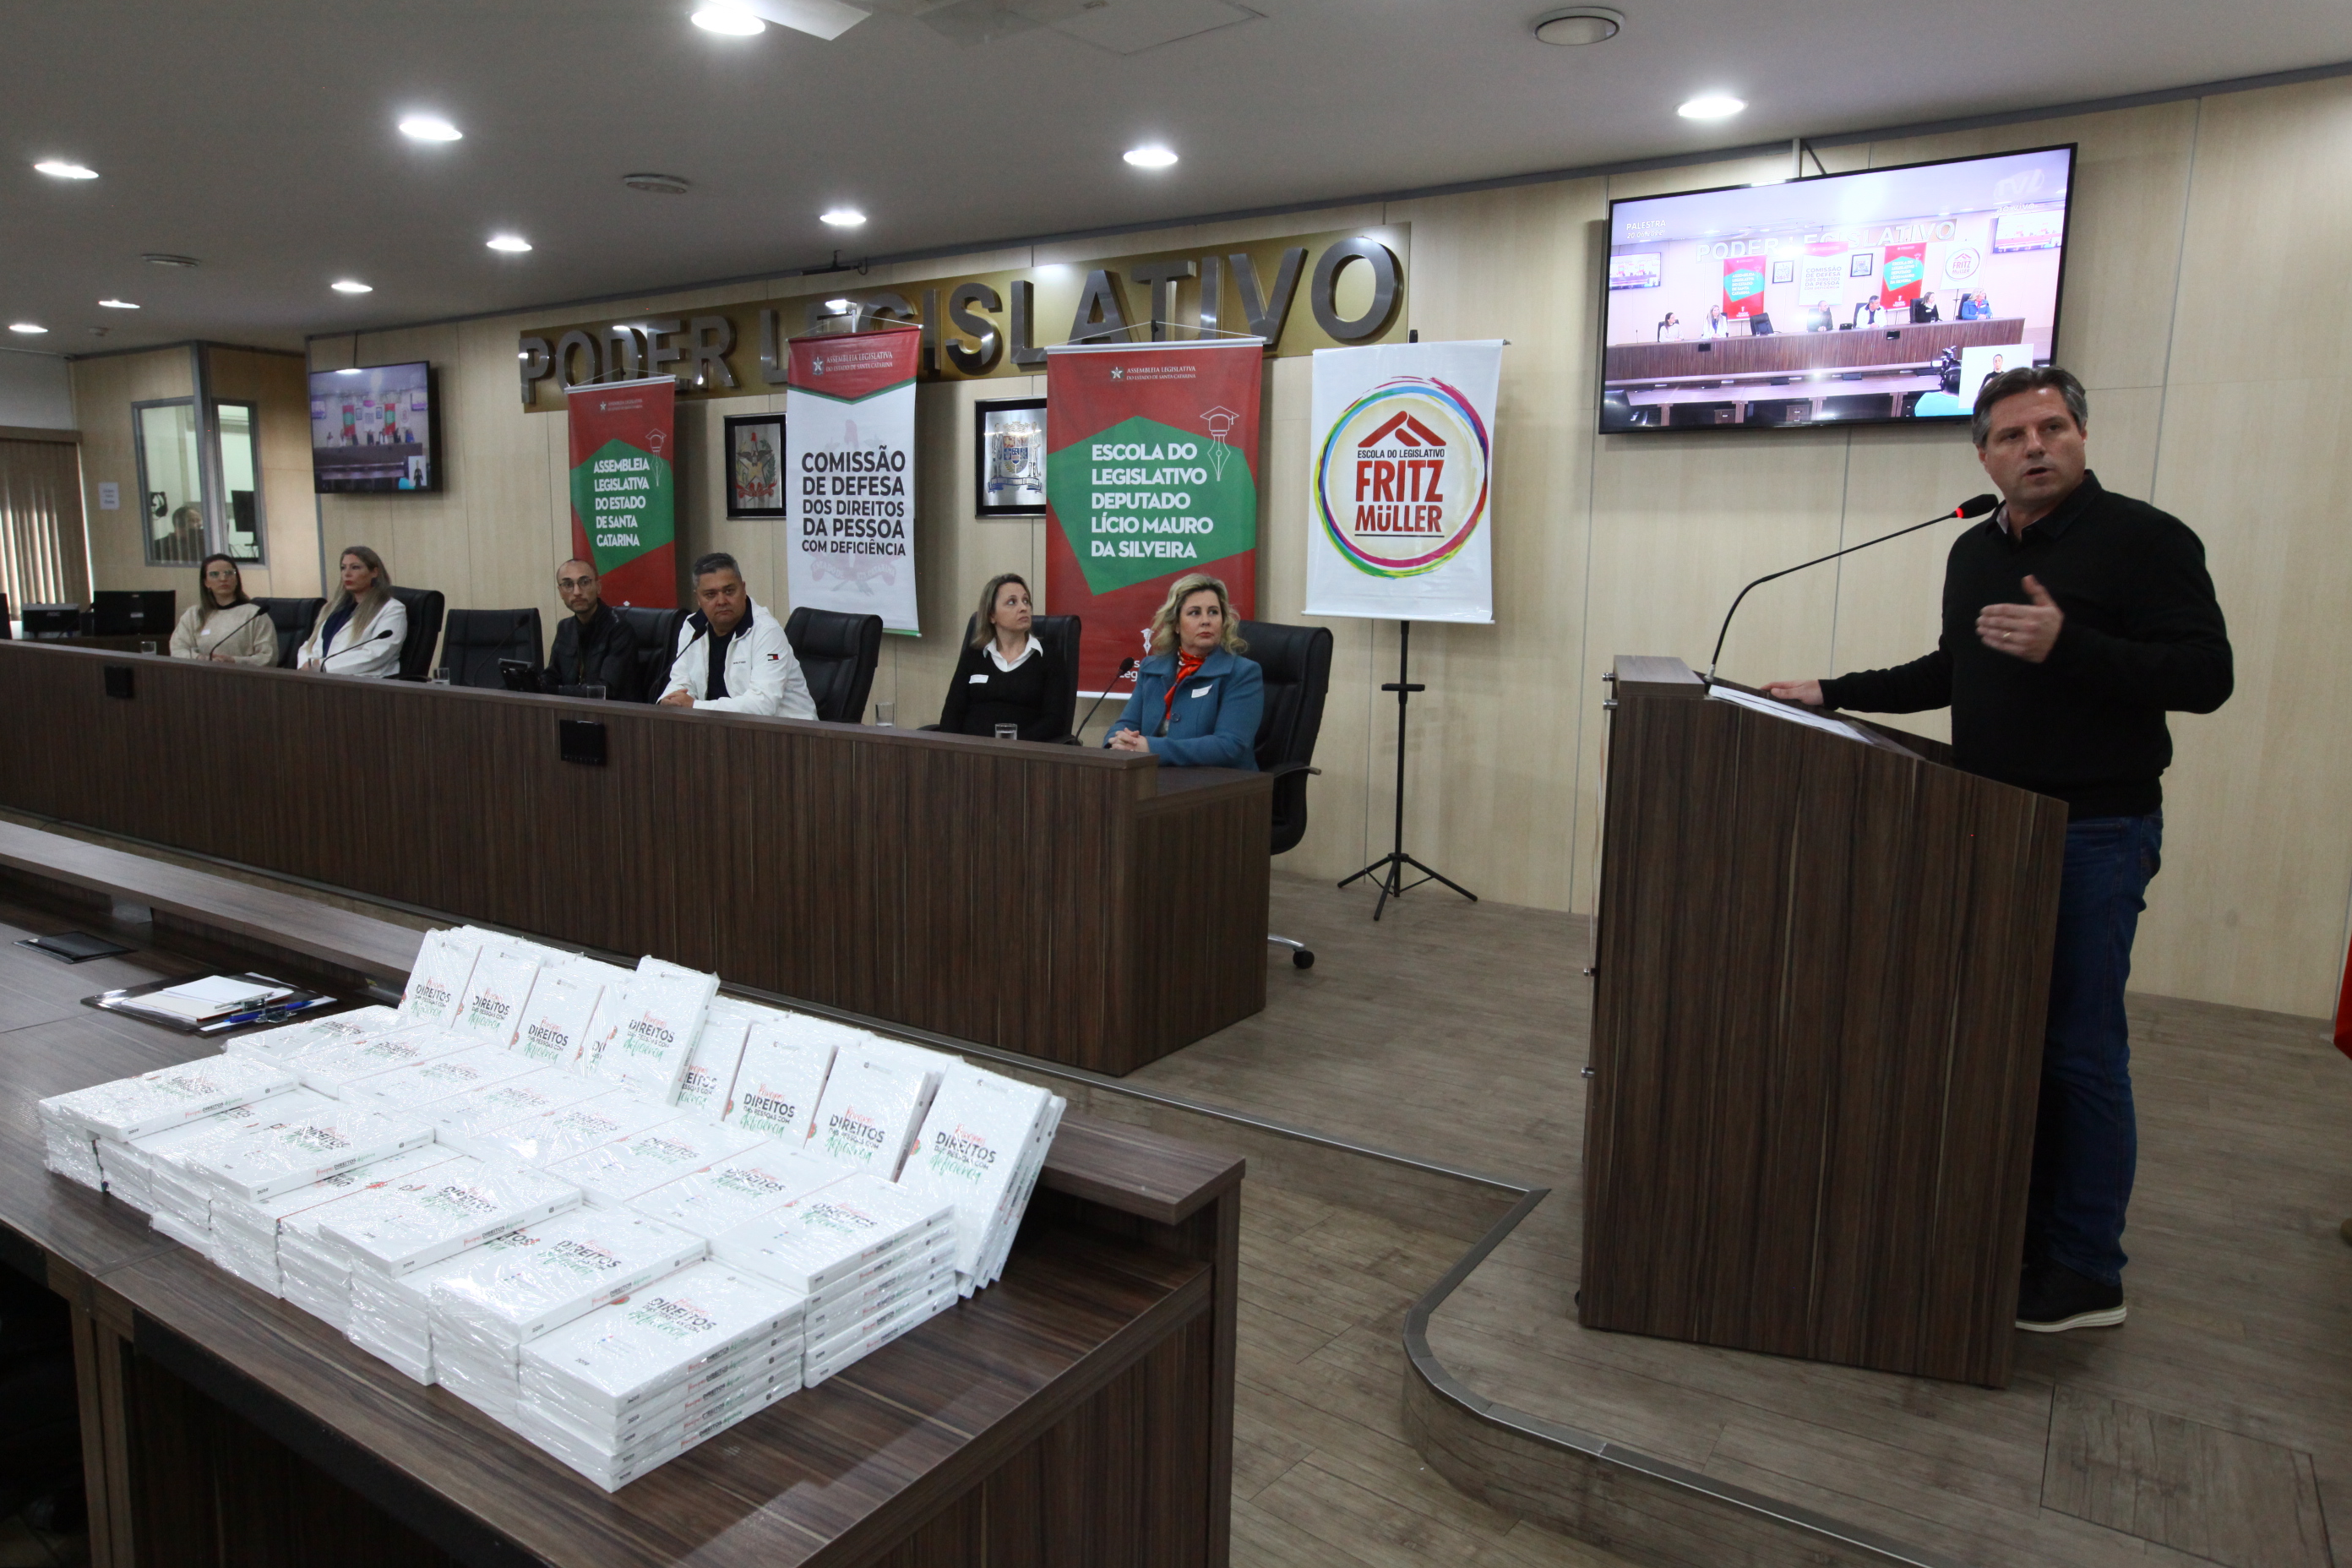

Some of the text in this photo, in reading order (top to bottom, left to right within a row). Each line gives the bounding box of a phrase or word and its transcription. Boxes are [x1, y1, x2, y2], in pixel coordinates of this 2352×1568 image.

[1626, 220, 1666, 230] PALESTRA
[518, 314, 739, 405] PODER
[826, 351, 893, 362] ASSEMBLEIA LEGISLATIVA
[802, 445, 906, 472] COMISSÃO
[1092, 443, 1198, 461] ESCOLA DO
[1358, 449, 1445, 458] ESCOLA DO LEGISLATIVO
[593, 458, 650, 473] ASSEMBLEIA
[594, 477, 650, 492] LEGISLATIVA
[1092, 467, 1207, 485] LEGISLATIVO
[1355, 460, 1445, 502] FRITZ
[803, 476, 905, 496] DE DEFESA
[596, 496, 646, 510] DO ESTADO
[803, 499, 904, 518] DOS DIREITOS
[1092, 493, 1191, 509] DEPUTADO
[596, 515, 638, 528] DE SANTA
[803, 518, 905, 539] DA PESSOA
[1092, 512, 1214, 534] LÍCIO MAURO
[596, 534, 640, 547] CATARINA
[802, 539, 906, 556] COM DEFICIÊNCIA
[1091, 541, 1197, 558] DA SILVEIRA
[416, 984, 451, 1003] DIREITOS
[472, 996, 510, 1015] DIREITOS
[528, 1024, 569, 1047] DIREITOS
[629, 1019, 675, 1043] DIREITOS
[682, 1083, 700, 1092] ESSOAS
[686, 1072, 717, 1090] EITOS
[203, 1102, 224, 1112] DIREITOS
[743, 1093, 795, 1118] DIREITOS
[829, 1114, 885, 1143] DIREITOS
[935, 1132, 997, 1163] DIREITOS
[334, 1158, 357, 1169] DIREITOS
[482, 1226, 505, 1238] DIREITOS
[557, 1240, 622, 1267] DIREITOS
[610, 1282, 632, 1296] DIREITOS
[647, 1298, 717, 1331] DIREITOS
